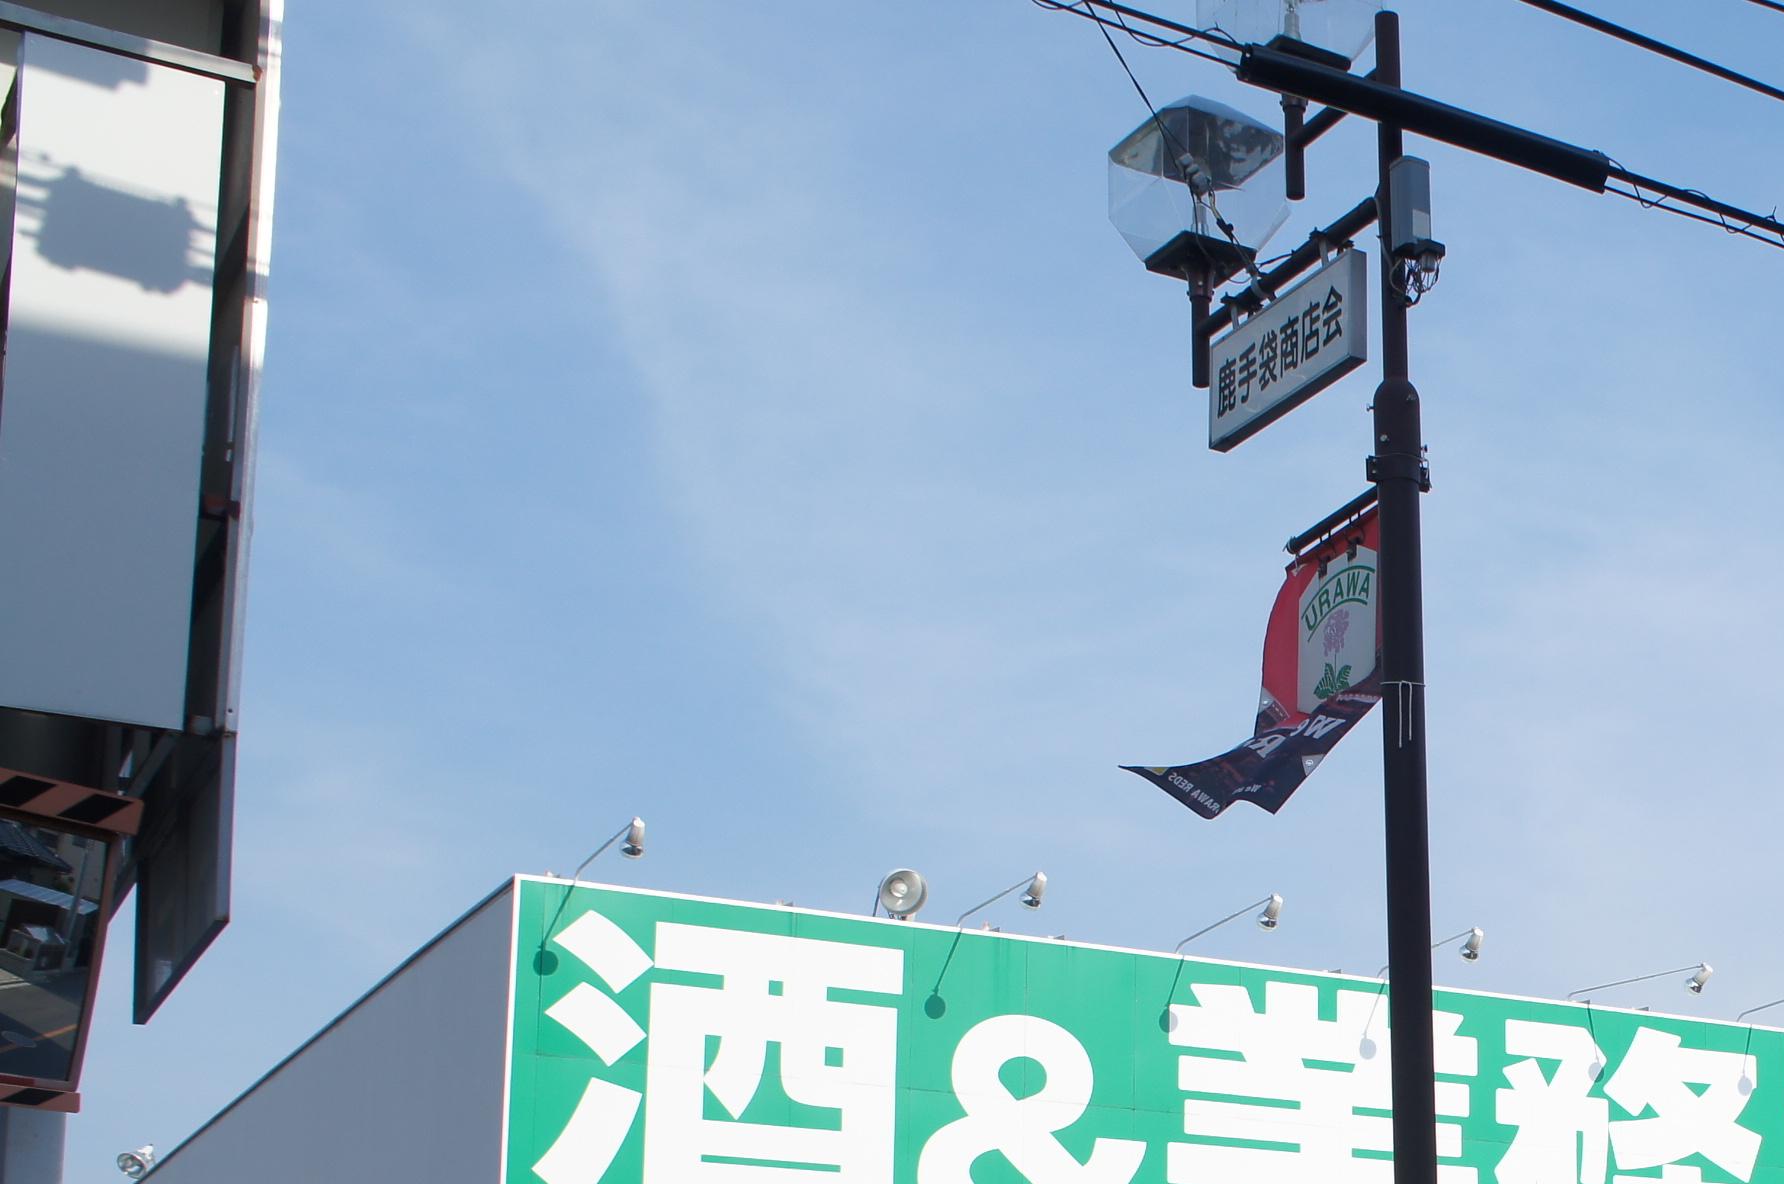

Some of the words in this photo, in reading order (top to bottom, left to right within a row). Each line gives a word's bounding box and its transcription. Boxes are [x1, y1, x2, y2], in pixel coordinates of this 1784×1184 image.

[1217, 285, 1343, 419] 鹿手袋商店会
[1303, 570, 1371, 632] URAWA
